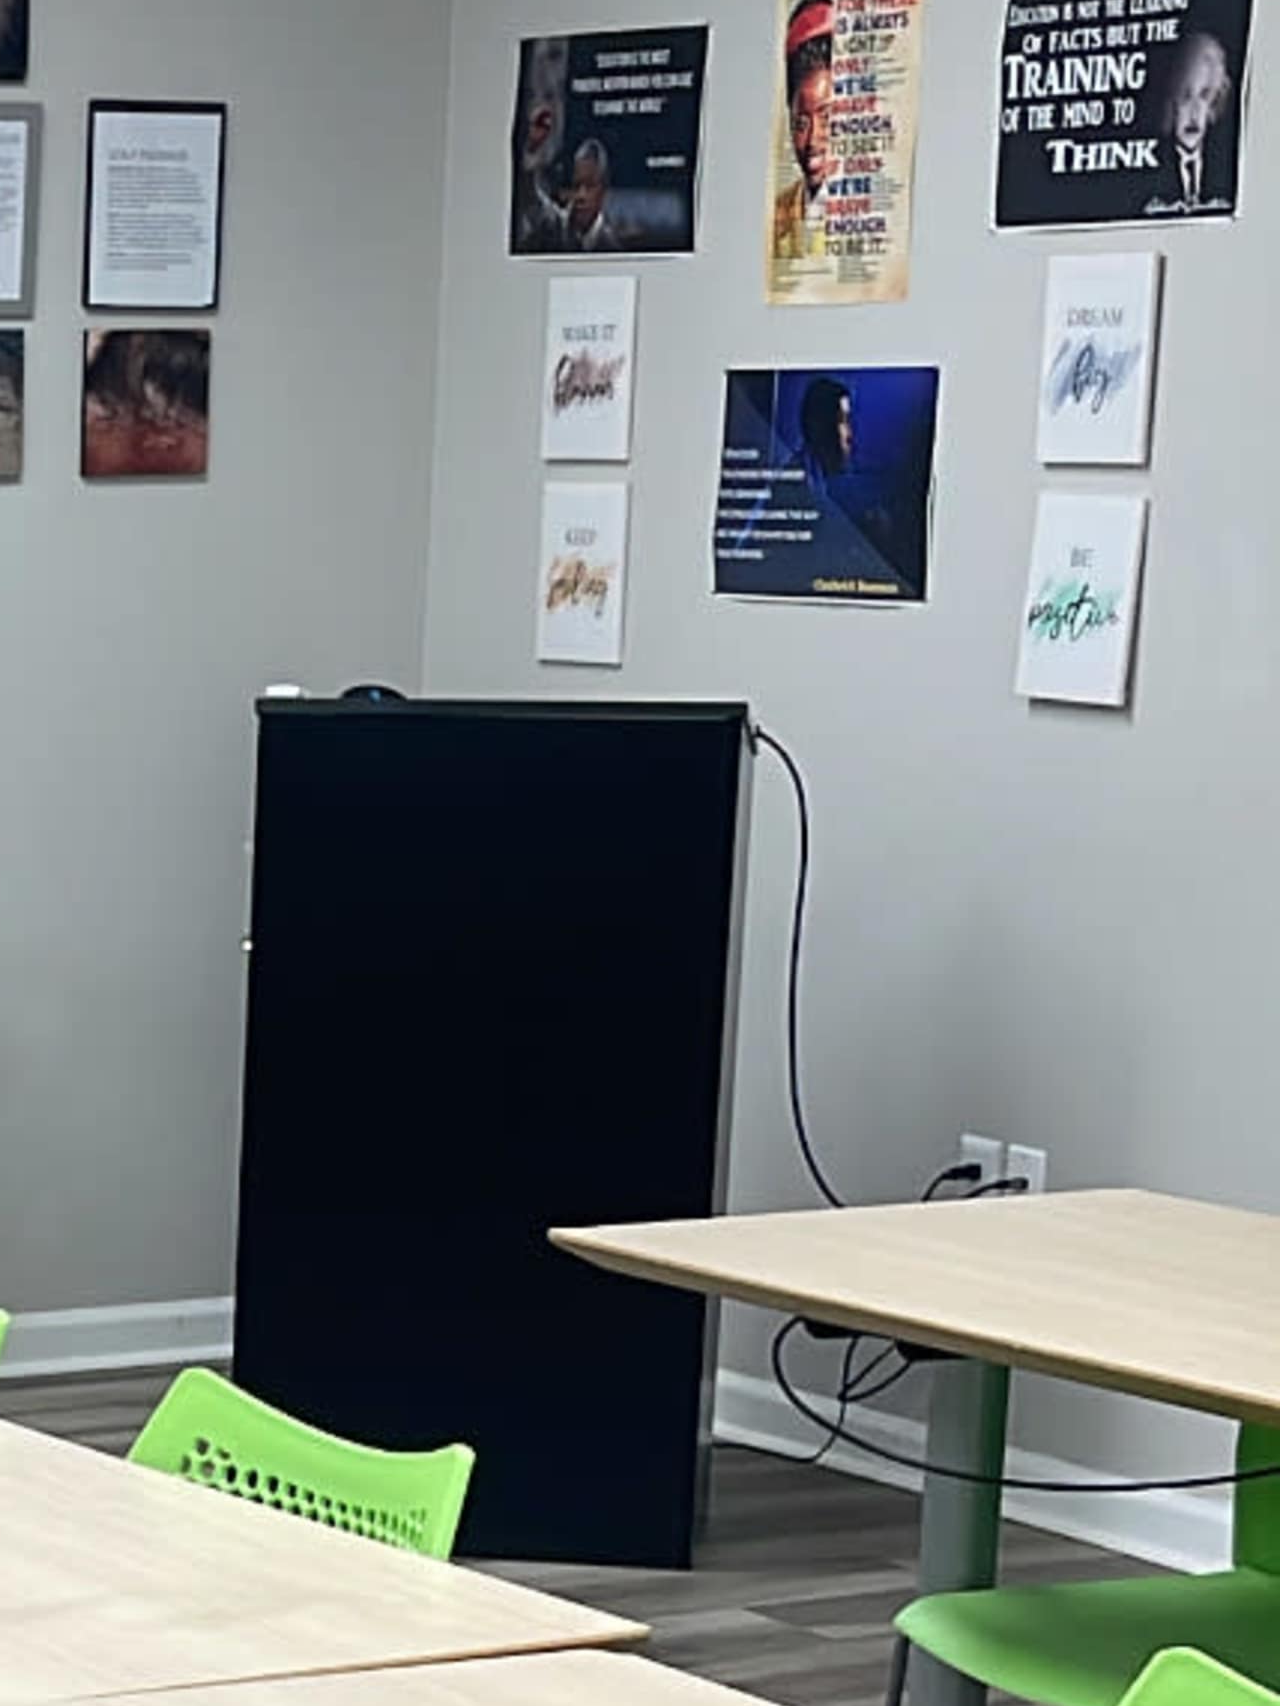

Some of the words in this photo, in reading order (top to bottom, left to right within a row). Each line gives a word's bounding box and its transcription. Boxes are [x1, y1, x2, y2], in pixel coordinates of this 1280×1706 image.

[1077, 0, 1100, 19] NOT
[852, 10, 909, 32] ALWAYS
[1022, 33, 1043, 54] OF
[1048, 27, 1103, 53] FACTS
[1106, 22, 1141, 47] BUT
[1145, 18, 1181, 42] THE
[1002, 52, 1146, 100] TRAINING
[1000, 106, 1021, 133] OF
[1027, 104, 1057, 132] THE
[1062, 100, 1105, 129] MIND
[1112, 96, 1136, 125] TO
[831, 115, 890, 136] ENOUGH
[1045, 139, 1159, 174] THINK
[824, 217, 886, 235] ENOUGH
[1067, 307, 1123, 327] DREAM
[1070, 547, 1096, 567] BE
